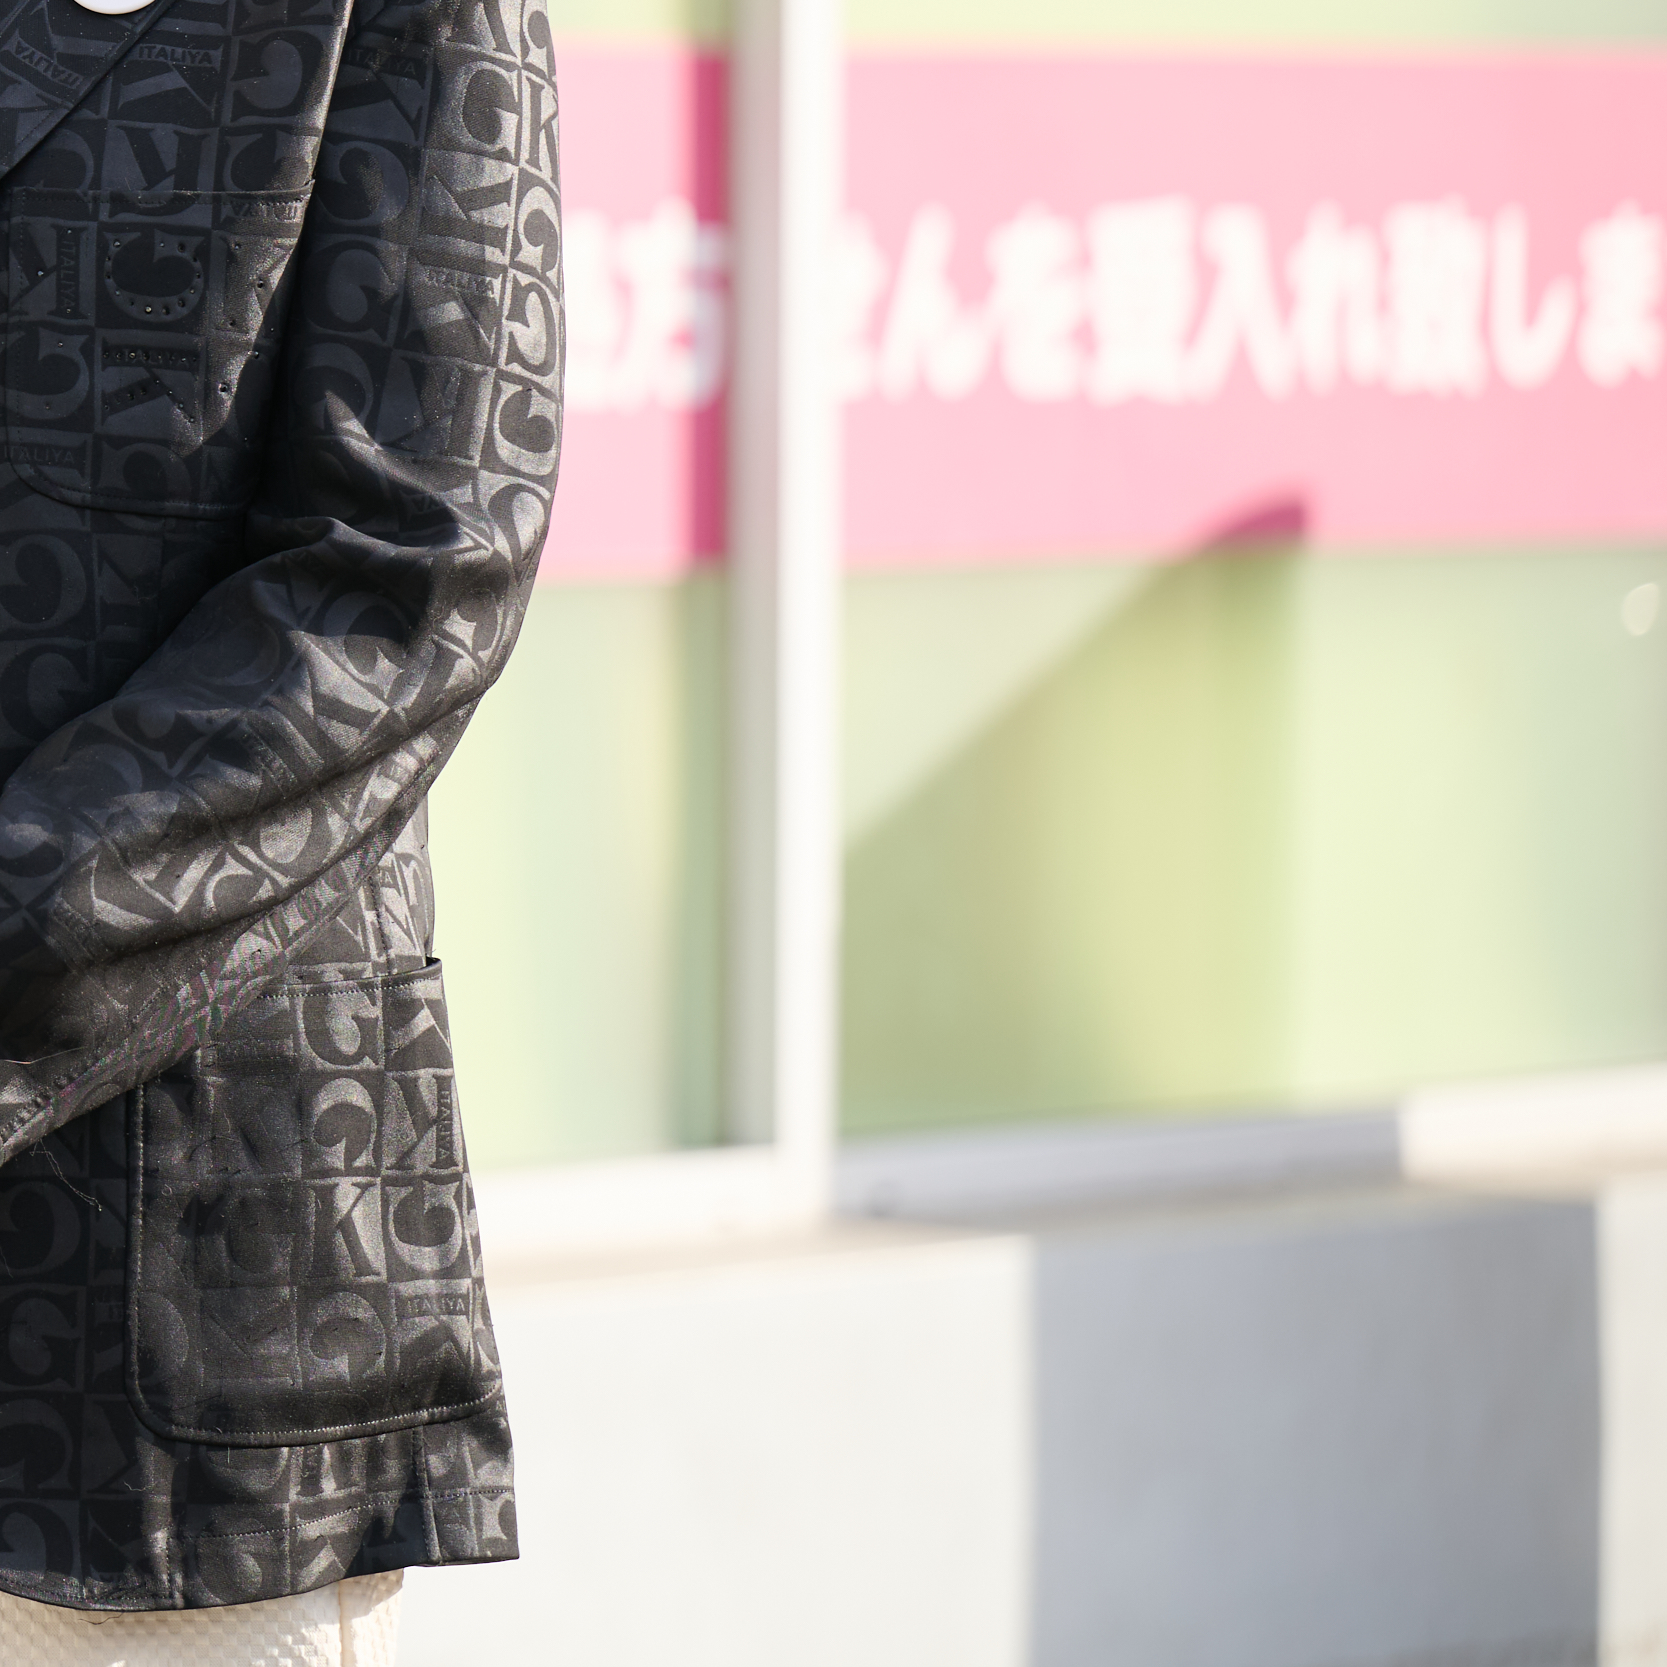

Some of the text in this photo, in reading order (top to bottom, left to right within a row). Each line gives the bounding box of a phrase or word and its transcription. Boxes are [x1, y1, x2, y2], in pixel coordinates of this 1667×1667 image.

[138, 43, 213, 66] ITALIYA
[60, 243, 77, 311] ITALIYA
[2, 444, 76, 464] ITALIYA
